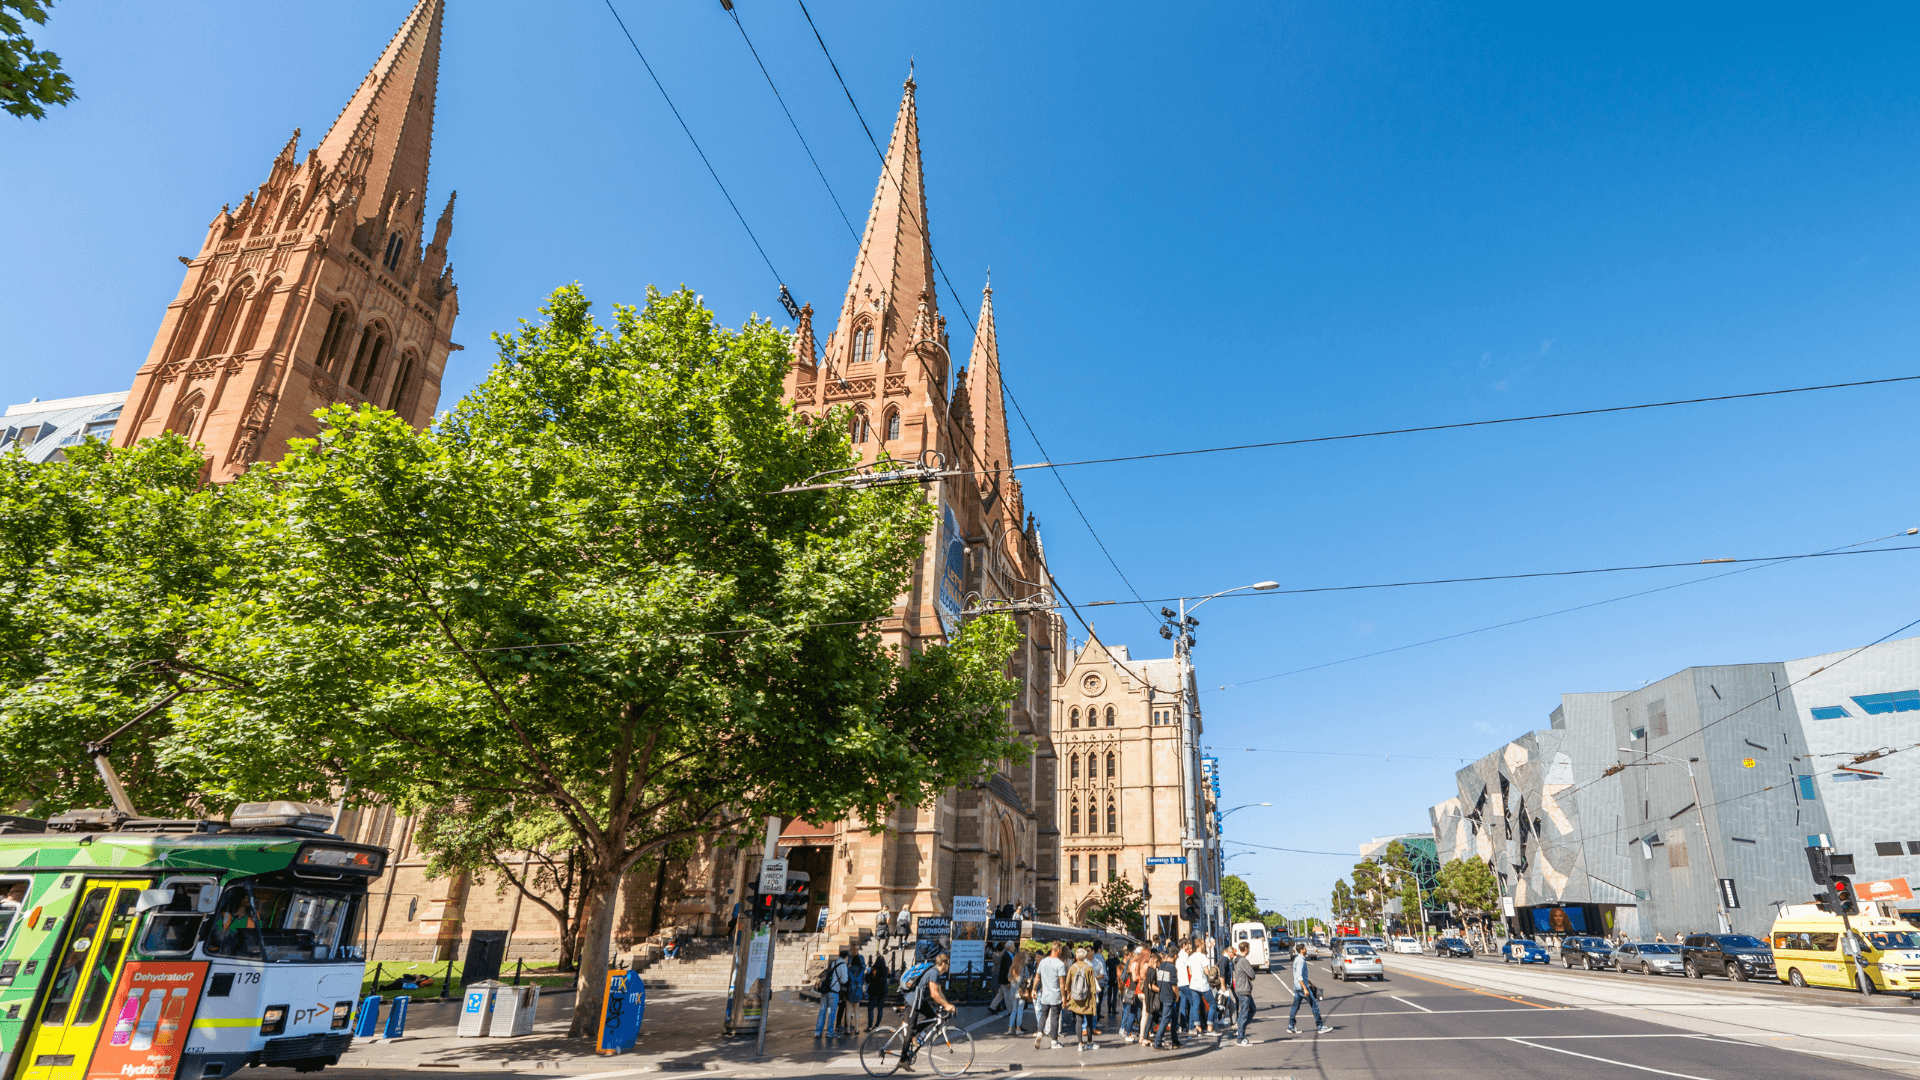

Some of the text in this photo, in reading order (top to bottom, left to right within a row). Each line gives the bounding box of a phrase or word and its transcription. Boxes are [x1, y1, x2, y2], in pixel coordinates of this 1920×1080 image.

[918, 918, 950, 927] CHORAL
[995, 920, 1017, 928] YOUR
[133, 972, 194, 983] Dehydrated?
[236, 972, 261, 984] 178
[121, 1064, 172, 1077] Hydralyte
